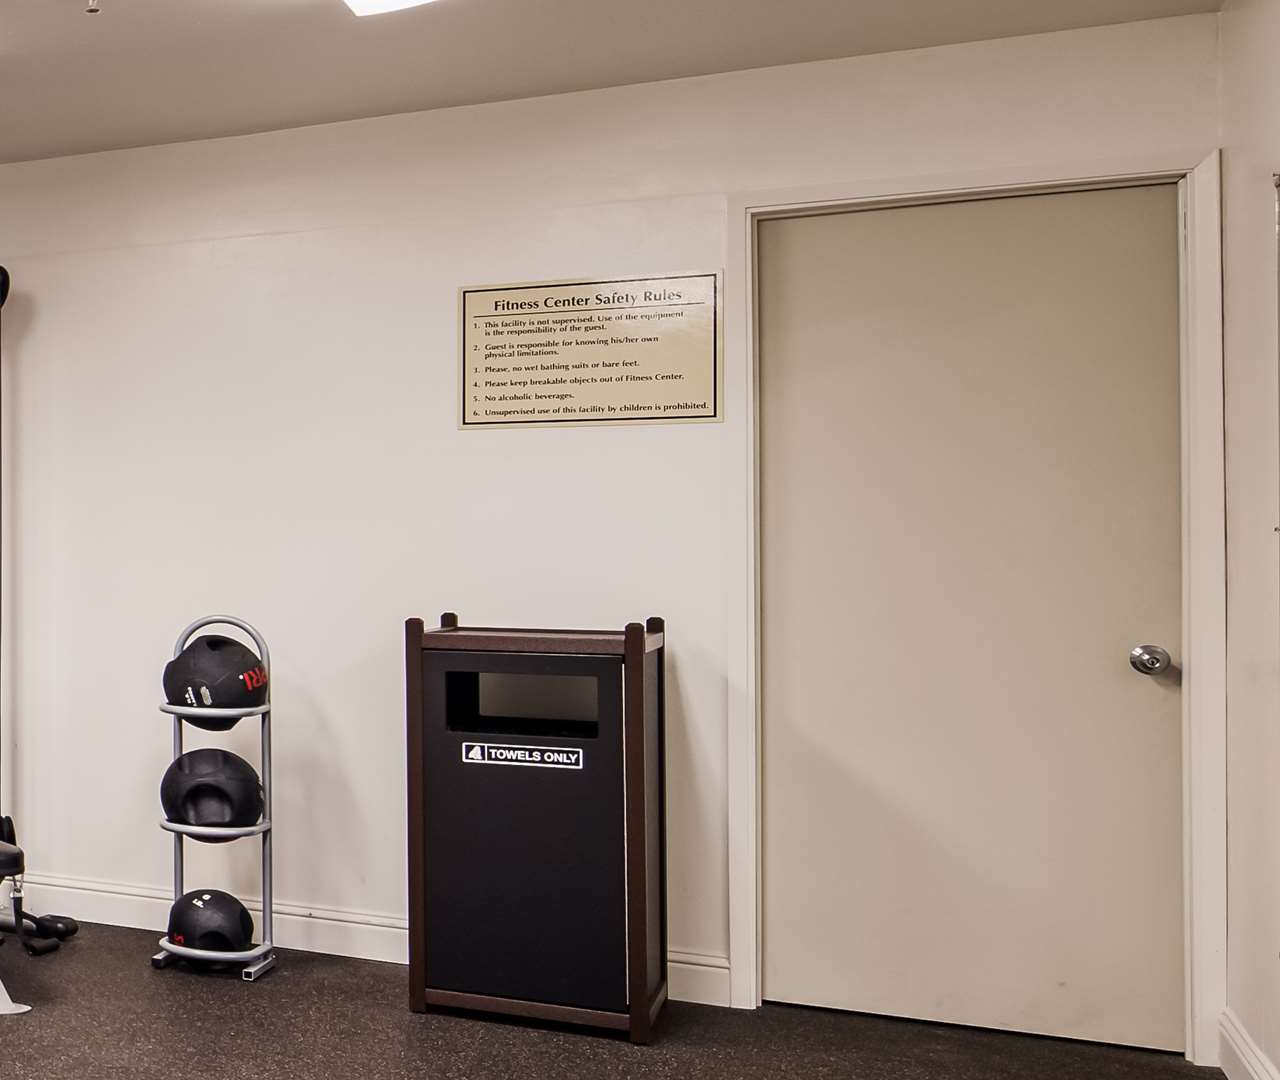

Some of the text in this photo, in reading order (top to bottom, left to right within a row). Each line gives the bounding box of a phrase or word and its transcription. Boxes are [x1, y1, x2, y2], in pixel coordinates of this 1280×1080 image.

[494, 288, 683, 312] Fitness Center Safety Rules
[501, 319, 527, 328] facility
[551, 315, 595, 326] supervised.
[614, 313, 624, 321] of
[640, 310, 684, 321] equipment
[506, 326, 558, 337] responsibility
[569, 324, 582, 332] the
[583, 323, 608, 332] guest.
[484, 343, 507, 351] Guest
[516, 340, 560, 351] responsible
[561, 339, 573, 347] for
[575, 337, 609, 347] knowing
[610, 335, 639, 344] his/her
[484, 348, 560, 360] physical limitations.
[540, 362, 570, 371] bathing
[571, 361, 589, 369] suits
[602, 360, 620, 368] bare
[622, 359, 641, 367] feet.
[509, 379, 528, 388] keep
[529, 377, 568, 385] breakable
[569, 375, 598, 385] objects
[625, 374, 653, 382] Fitness
[498, 393, 532, 401] alcoholic
[534, 392, 575, 401] beverages.
[484, 407, 536, 417] Unsupervised
[552, 406, 561, 414] of
[578, 404, 605, 413] facility
[607, 404, 617, 413] by
[619, 403, 653, 412] children
[663, 401, 710, 412] prohibited.
[488, 748, 578, 764] TOWELS ONLY
